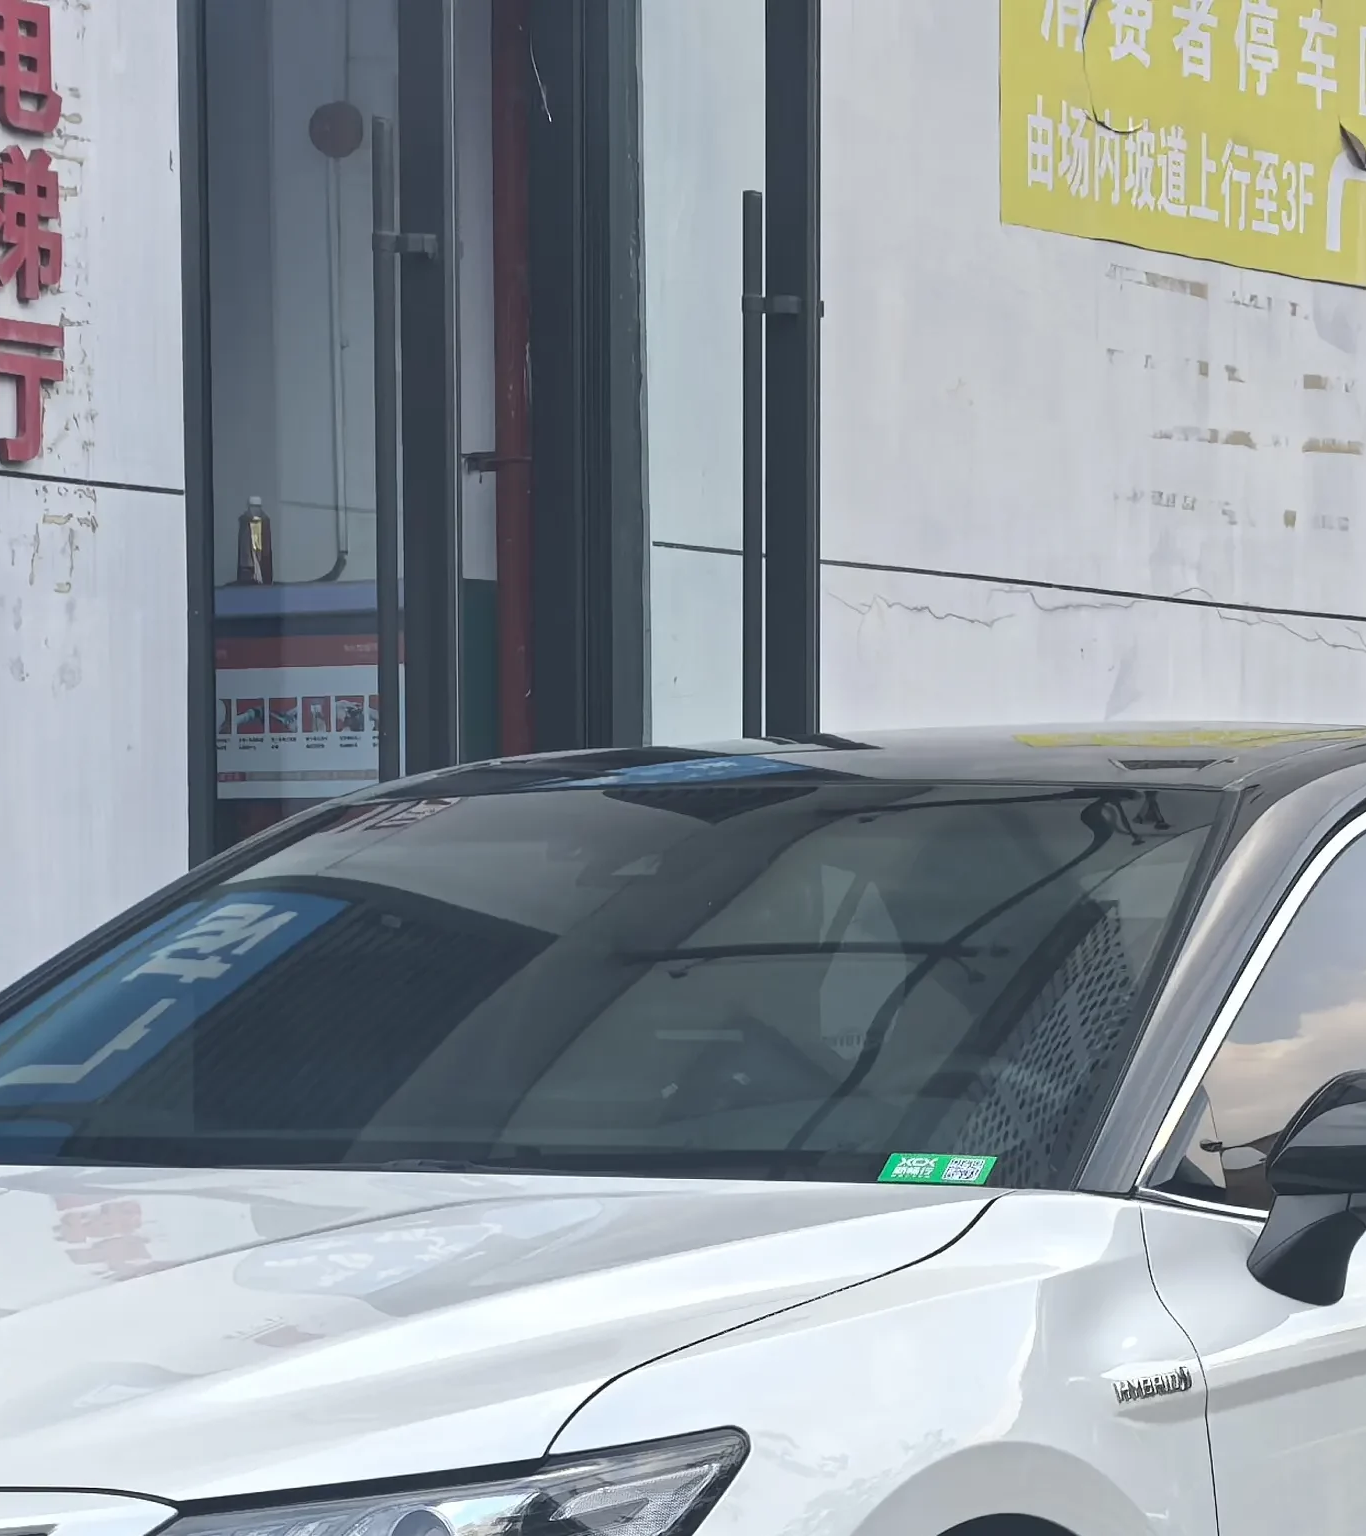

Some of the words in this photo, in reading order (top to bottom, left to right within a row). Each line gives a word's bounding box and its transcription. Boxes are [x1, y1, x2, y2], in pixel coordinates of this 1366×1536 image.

[1026, 94, 1315, 237] 由场内坡道上行至3F
